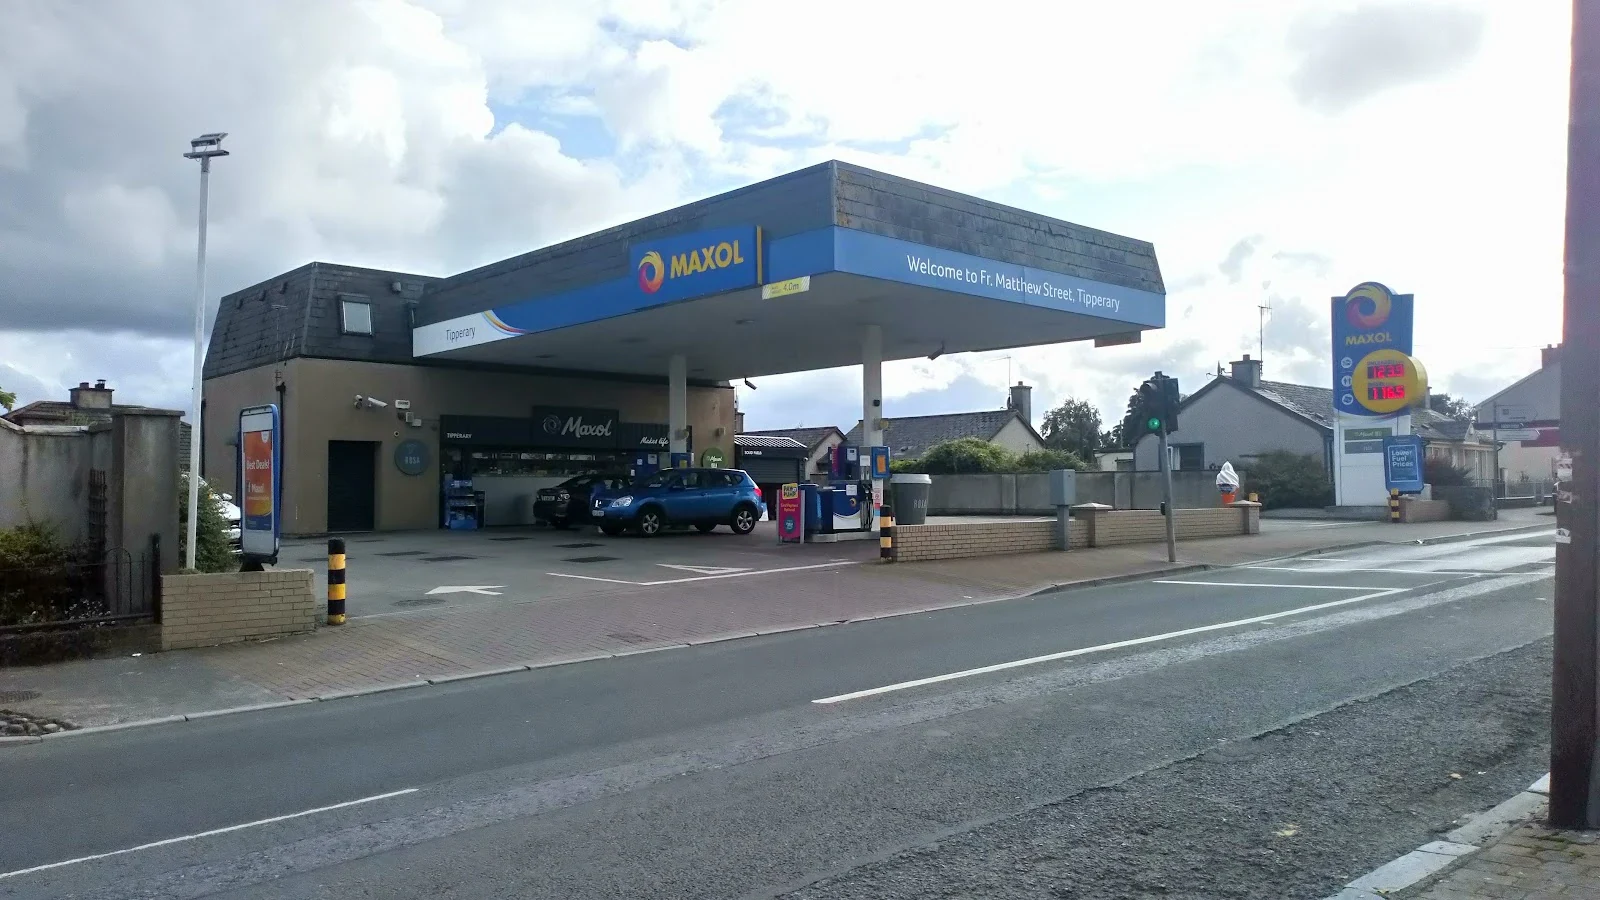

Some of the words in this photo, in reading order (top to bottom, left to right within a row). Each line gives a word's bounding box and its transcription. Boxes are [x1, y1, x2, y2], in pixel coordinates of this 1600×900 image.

[670, 239, 744, 279] MAXOL
[907, 255, 963, 281] Welcome
[965, 269, 977, 283] to
[980, 270, 993, 286] Fr.
[996, 274, 1042, 295] Matthew
[1043, 282, 1075, 303] Street,
[1077, 288, 1120, 312] Tipperary
[445, 325, 476, 342] Tipperary
[1345, 332, 1392, 345] MAXOL
[561, 416, 612, 437] Maxol
